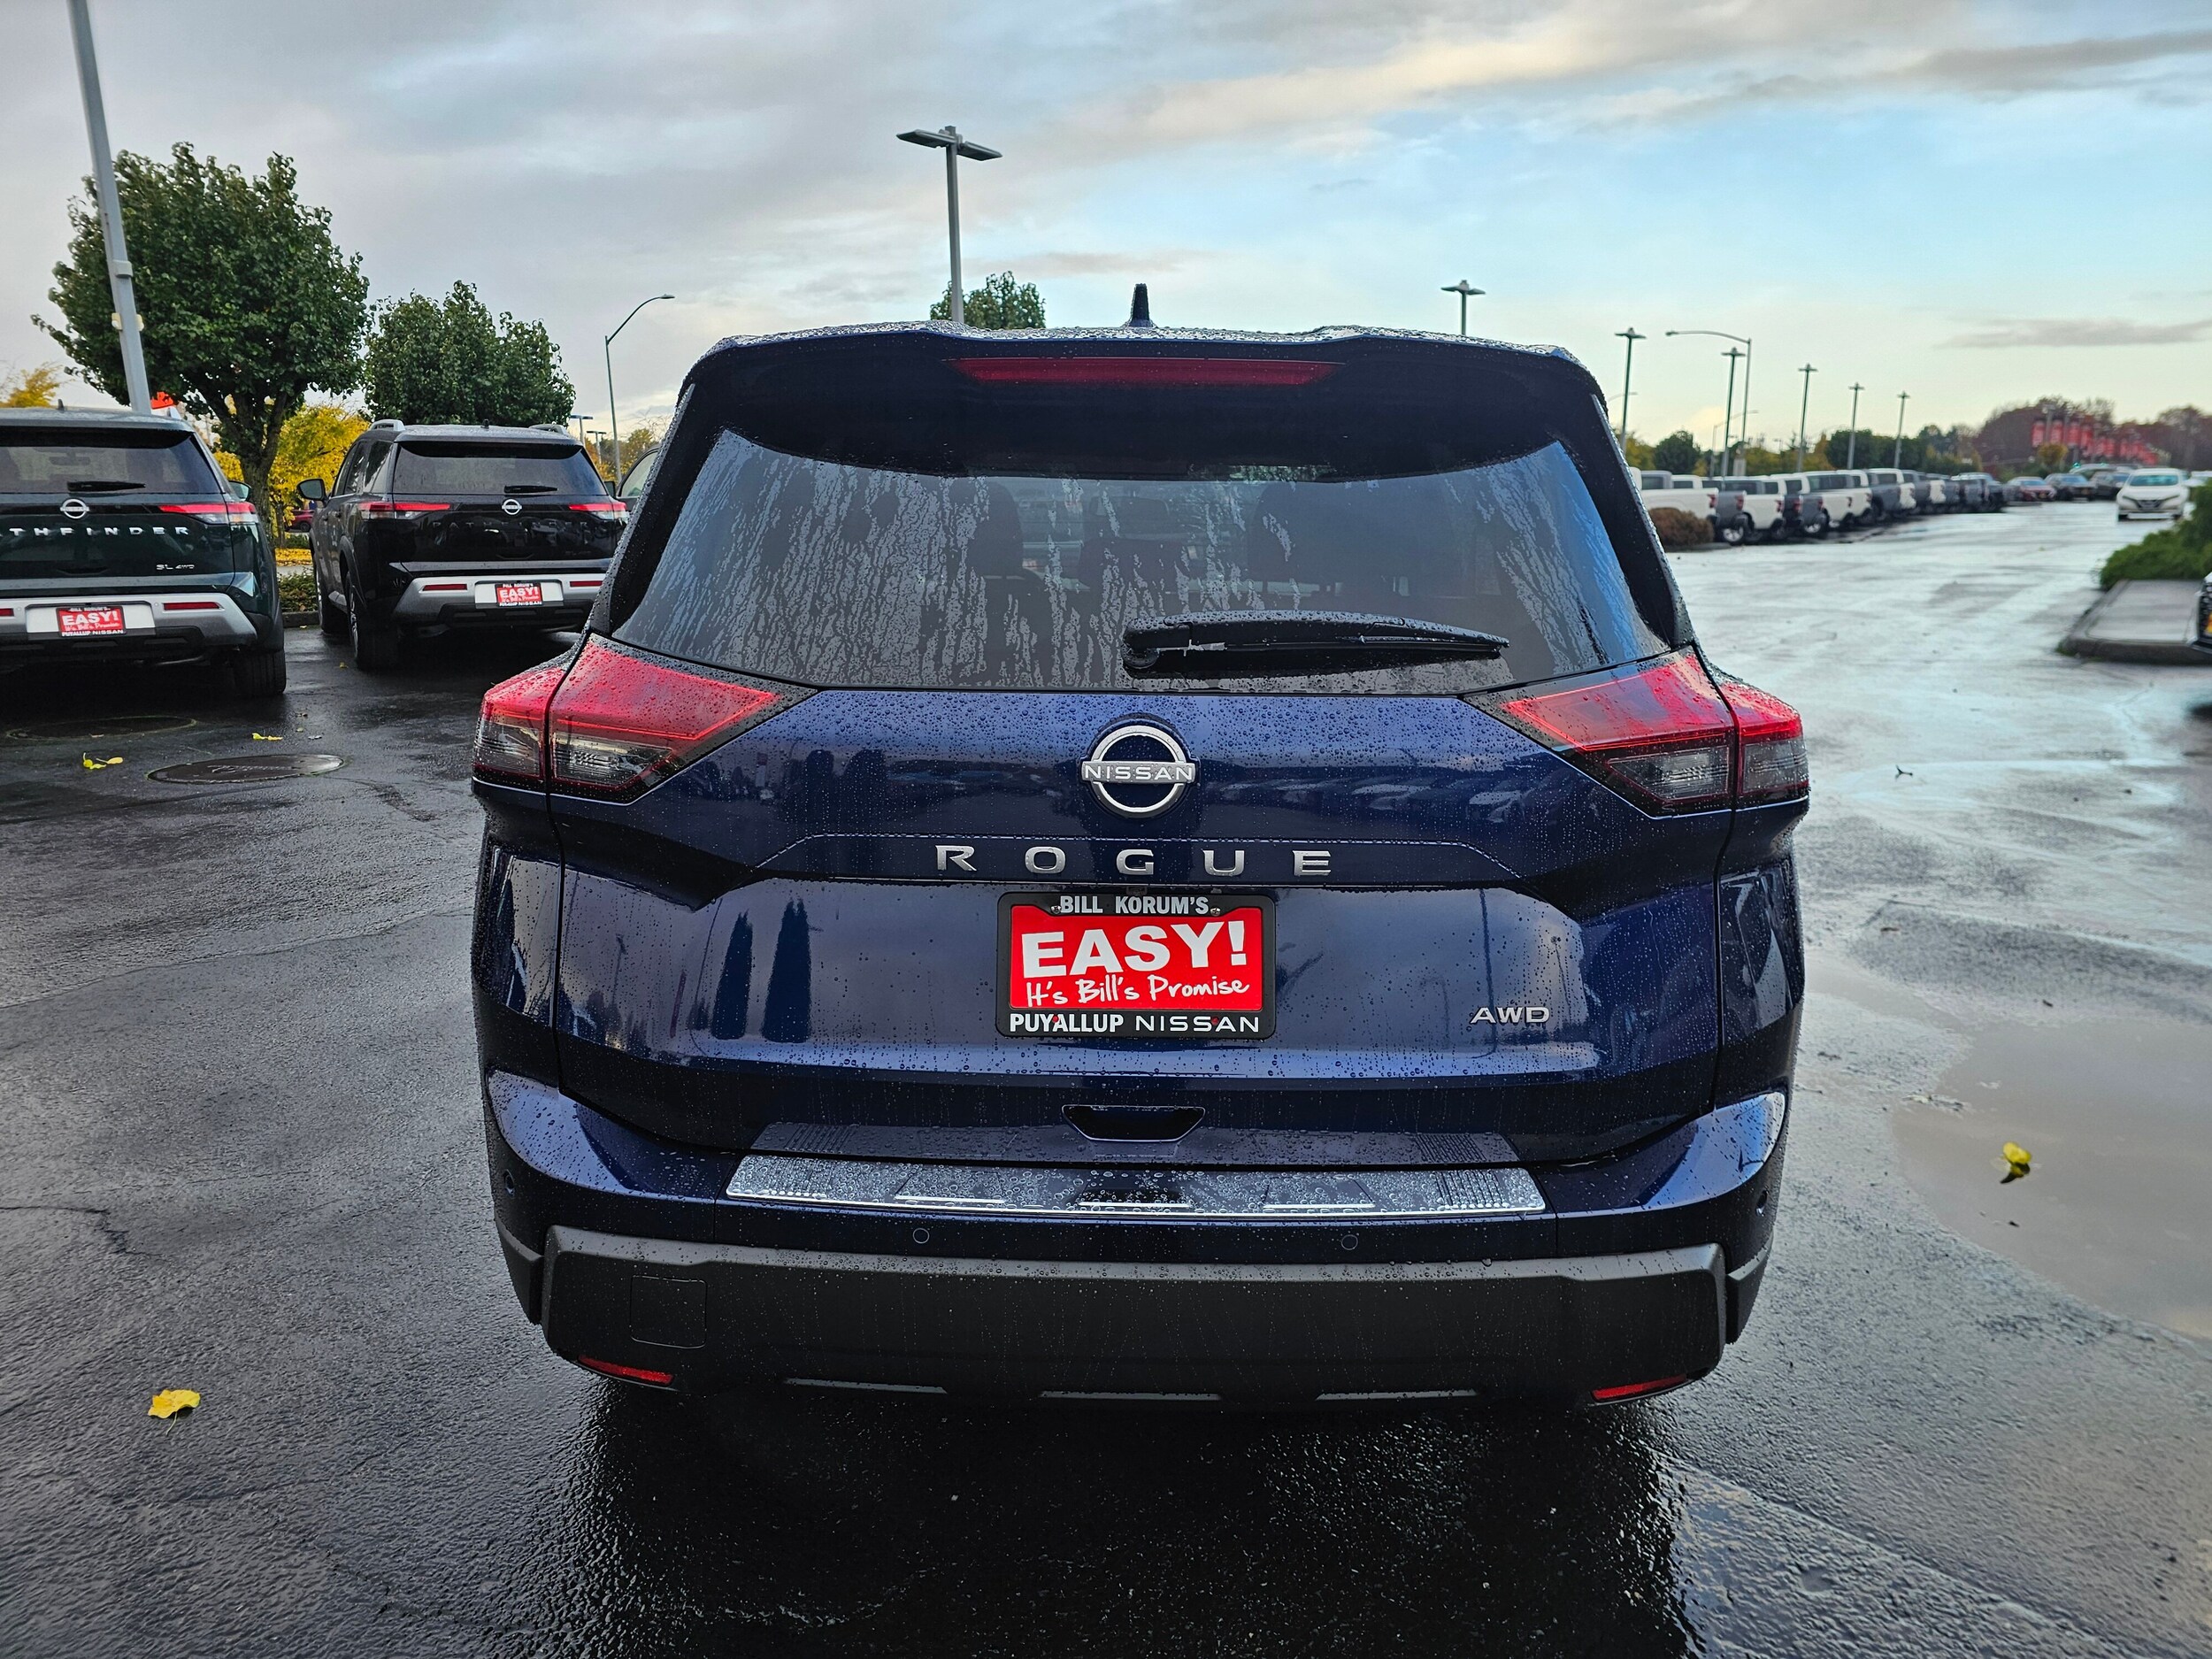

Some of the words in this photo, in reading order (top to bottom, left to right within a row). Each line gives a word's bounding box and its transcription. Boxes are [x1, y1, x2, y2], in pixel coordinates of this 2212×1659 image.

[0, 526, 190, 536] THFINDER
[499, 587, 538, 598] EASY!
[62, 611, 119, 626] EASY!
[1084, 764, 1194, 780] NISSAN
[934, 844, 1333, 877] ROGUE
[1059, 895, 1103, 914] BILL
[1115, 895, 1210, 916] KORUM'S
[1021, 920, 1248, 979] EASY!
[1025, 981, 1069, 1008] It's
[1077, 975, 1140, 1004] Bill's
[1150, 975, 1250, 997] Promise
[1010, 1013, 1124, 1033] PUYALLUP
[1135, 1015, 1260, 1033] NISSAN
[1470, 1006, 1550, 1024] AWD
